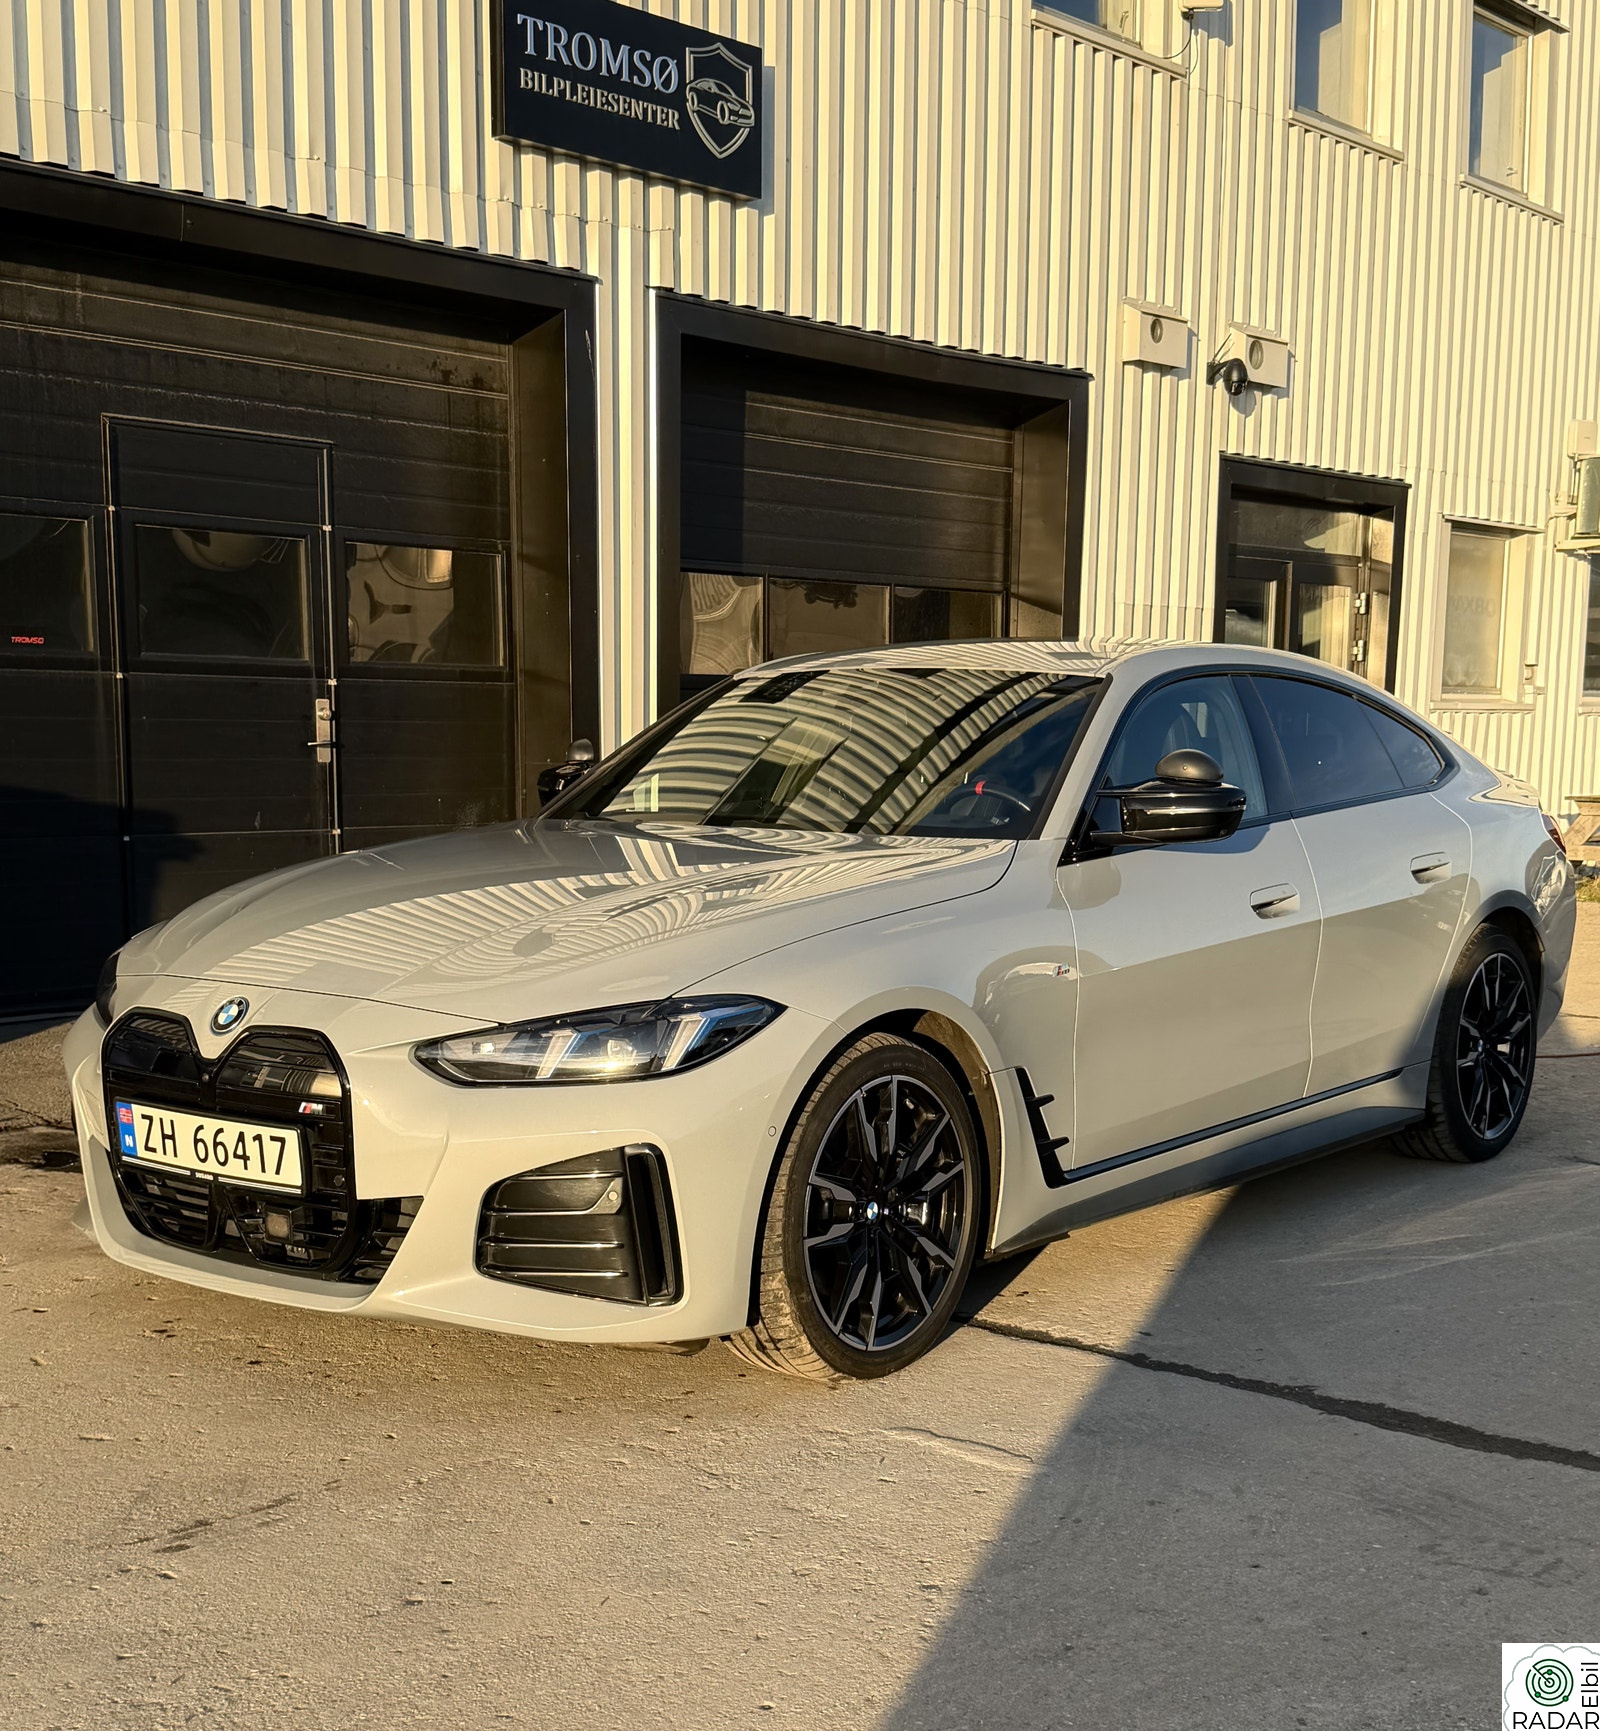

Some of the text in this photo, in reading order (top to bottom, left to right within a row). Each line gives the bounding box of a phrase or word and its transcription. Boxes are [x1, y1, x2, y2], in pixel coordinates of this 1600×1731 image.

[517, 13, 679, 94] TROMSØ
[519, 67, 681, 130] BILPLEIESENTER
[125, 1134, 134, 1148] N
[140, 1114, 287, 1176] ZH 66417
